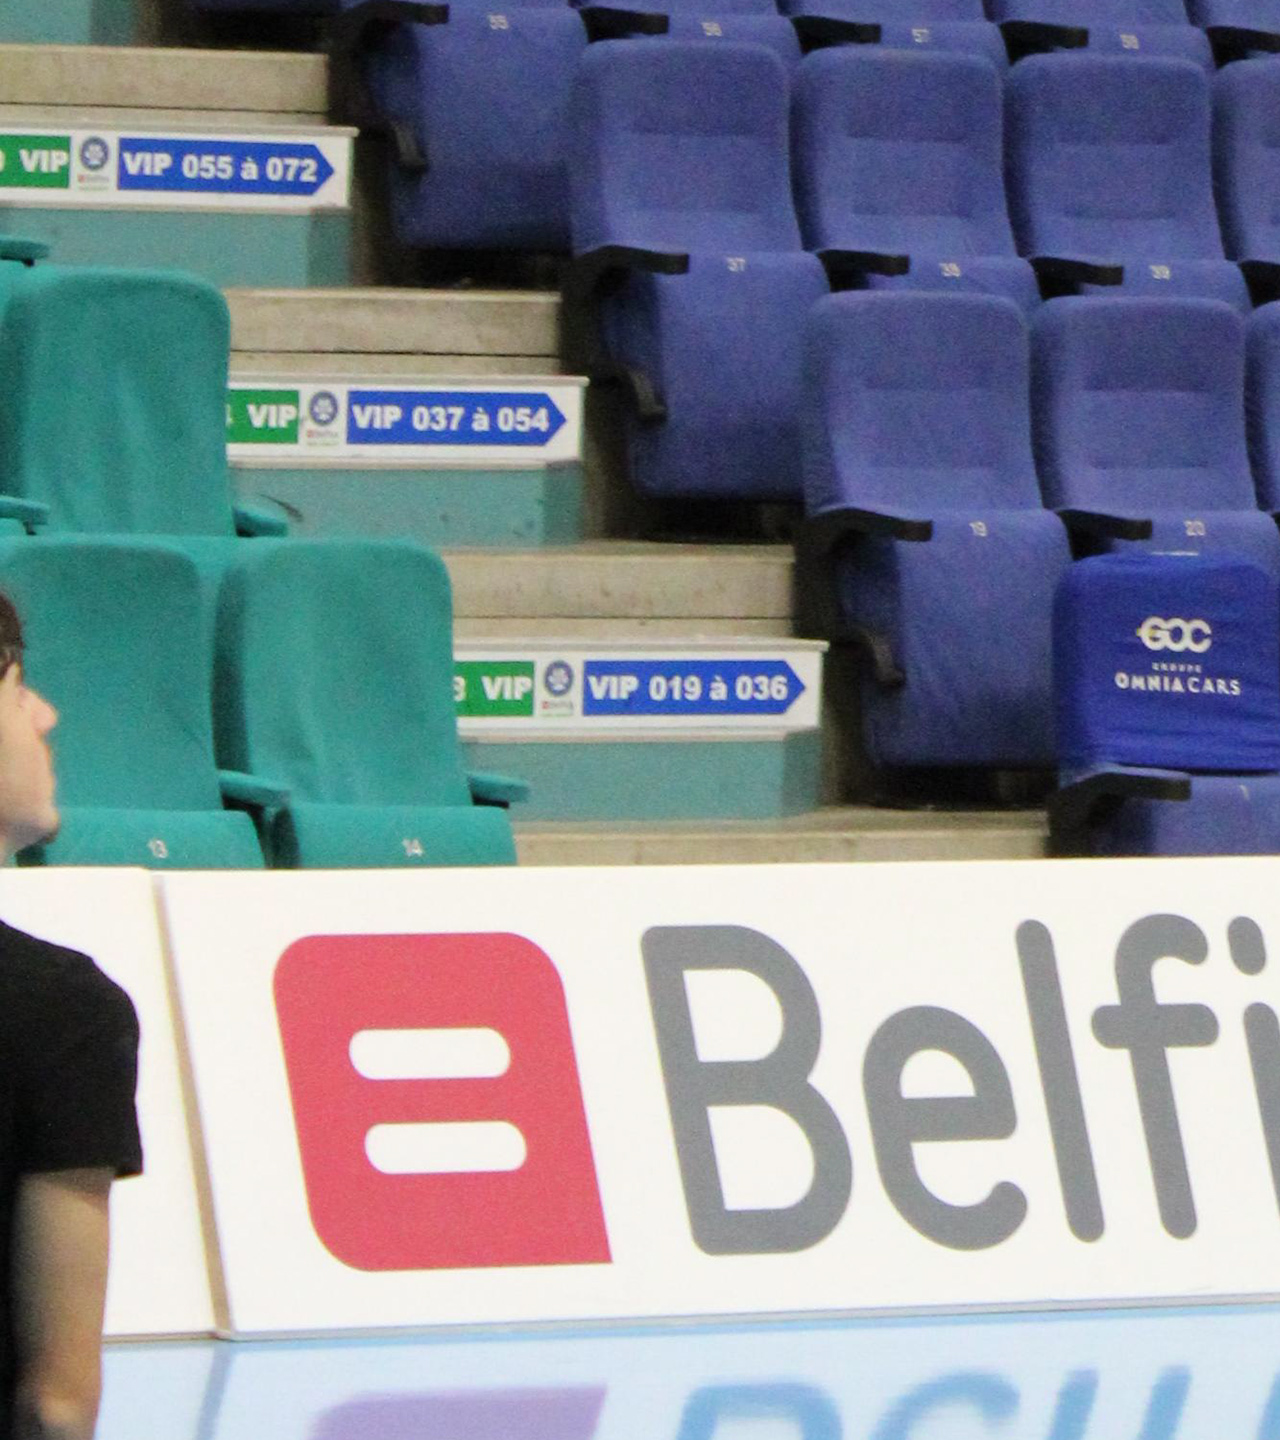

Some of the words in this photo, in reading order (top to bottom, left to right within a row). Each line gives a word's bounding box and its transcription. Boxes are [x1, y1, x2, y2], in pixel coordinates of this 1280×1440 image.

[19, 148, 69, 174] VIP
[123, 151, 173, 176] VIP
[182, 154, 234, 180] 055
[240, 156, 258, 180] à
[266, 157, 318, 183] 072
[247, 404, 299, 429] VIP
[352, 404, 402, 429] VIP
[411, 407, 465, 432] 037
[472, 407, 490, 432] à
[497, 407, 549, 432] 054
[1138, 616, 1211, 653] GOC
[481, 676, 533, 701] VIP
[588, 675, 639, 700] VIP
[649, 676, 701, 701] 019
[709, 676, 728, 701] à
[735, 675, 788, 701] 036
